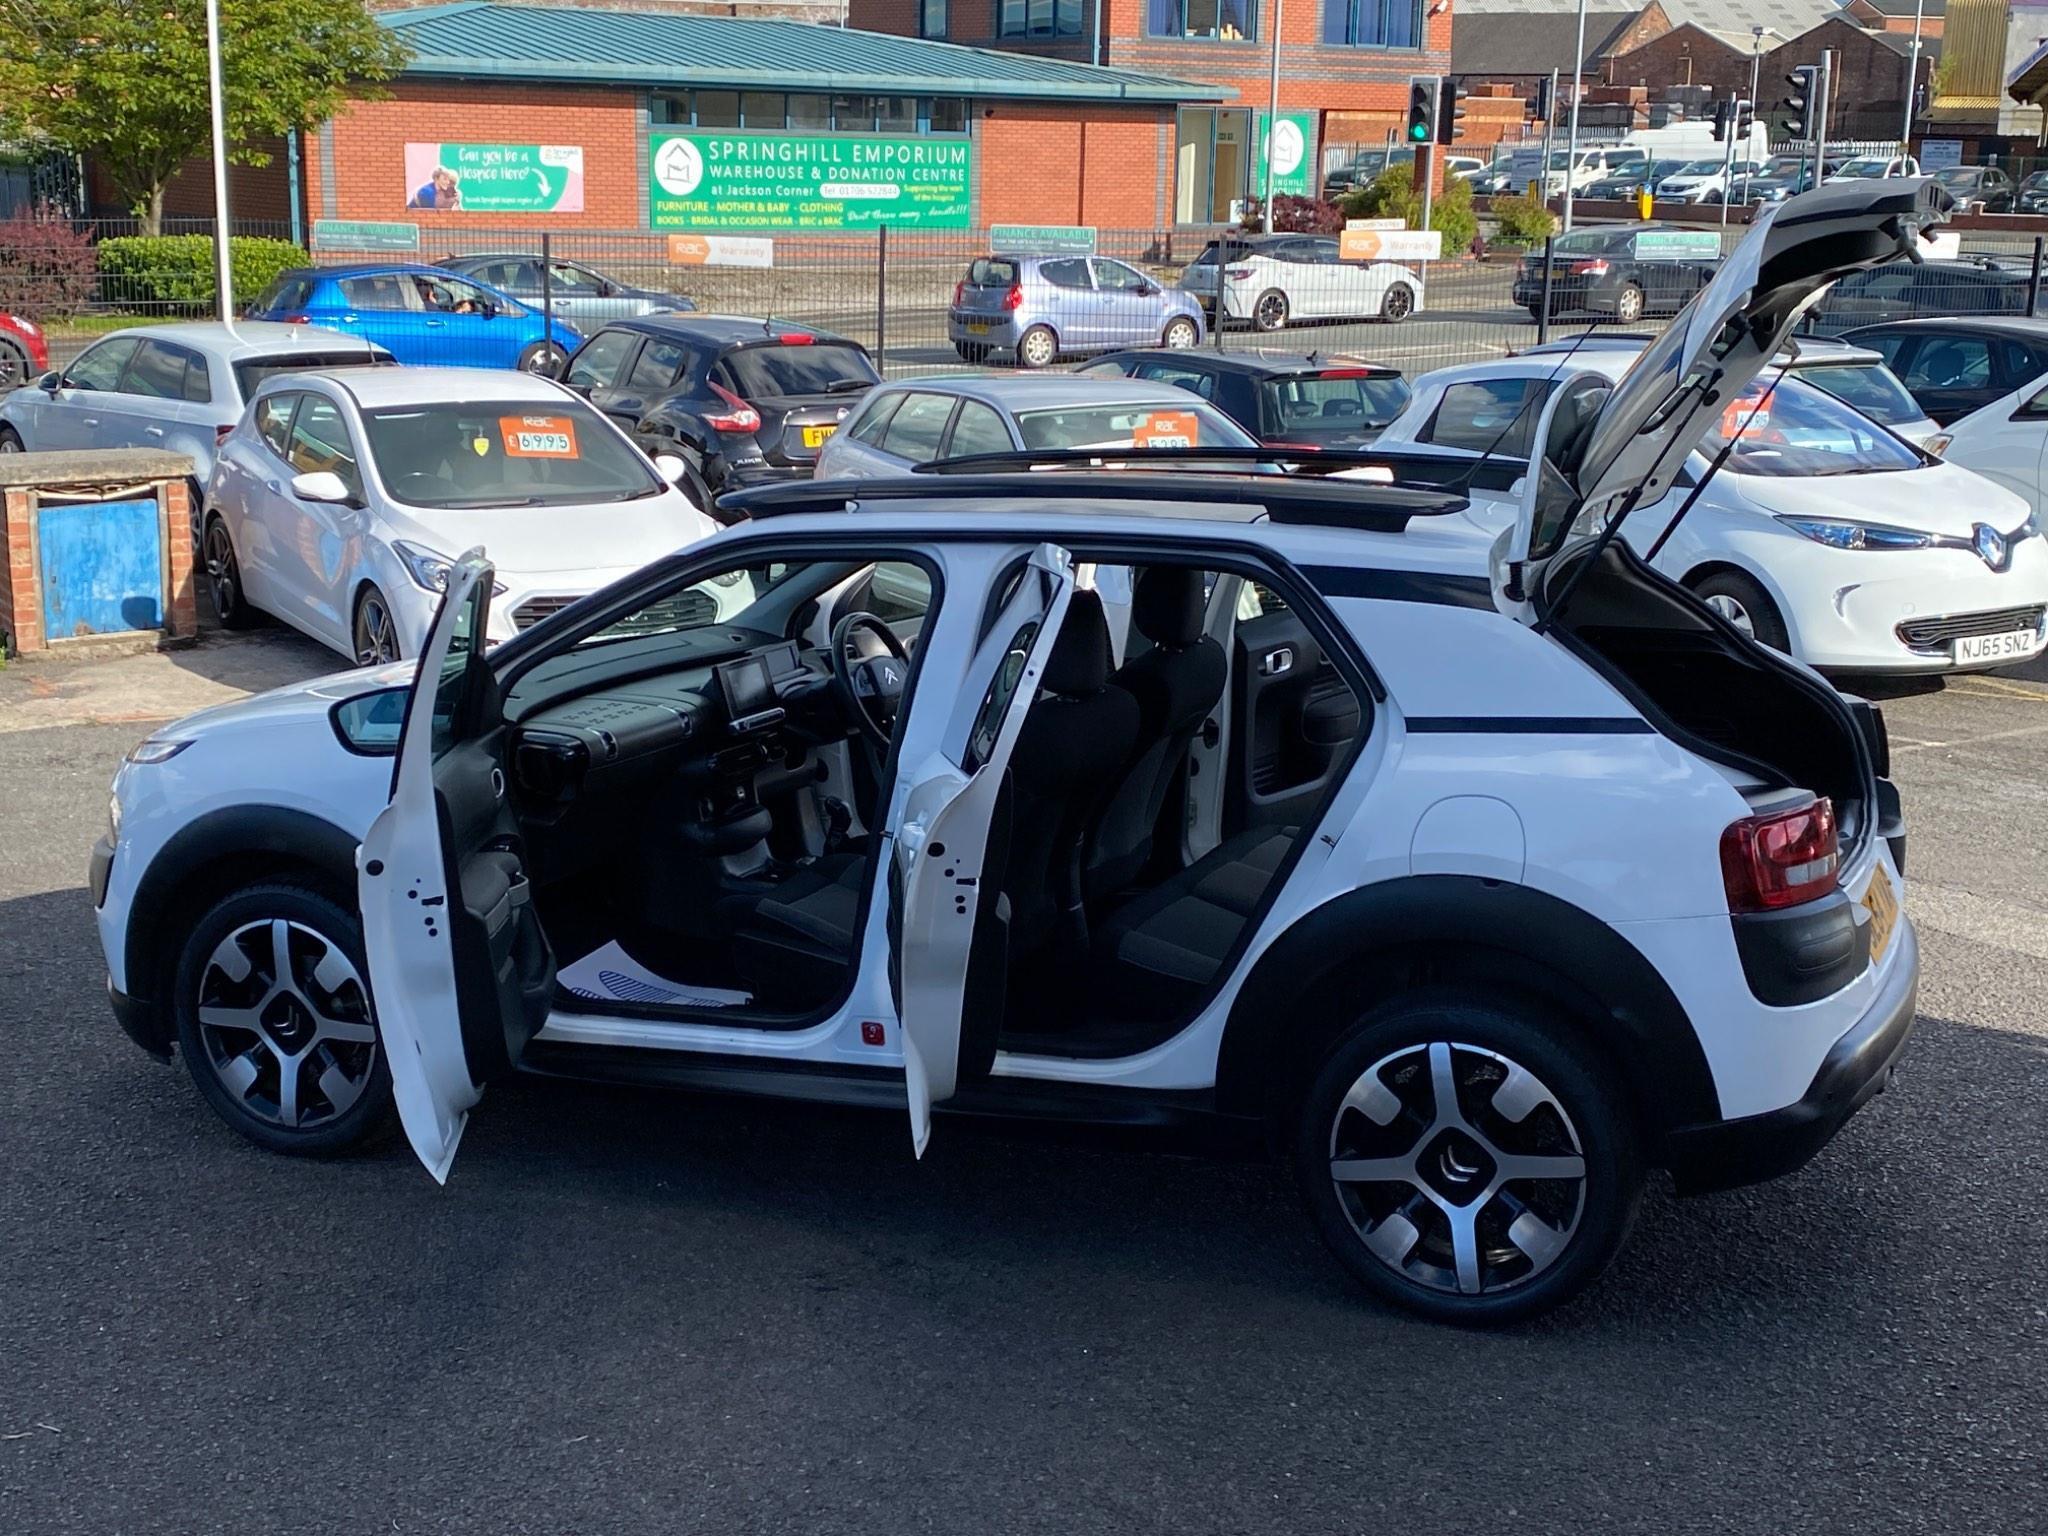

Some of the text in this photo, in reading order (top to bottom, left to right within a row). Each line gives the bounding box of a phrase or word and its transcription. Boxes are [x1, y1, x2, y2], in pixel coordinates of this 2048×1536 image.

[459, 147, 479, 162] Can
[482, 150, 501, 167] you
[504, 148, 518, 163] be
[709, 141, 965, 164] SPRINGHILL EMPORIUM
[459, 166, 498, 184] Hospice
[710, 165, 964, 182] WAREHOUSE & DONATION CENTRE
[711, 185, 722, 196] at
[727, 185, 771, 196] Jackson
[775, 185, 814, 197] Corner
[657, 201, 709, 212] FURNITURE
[716, 202, 755, 212] MOTHER
[757, 203, 765, 212] &
[767, 203, 789, 212] BABY
[800, 203, 843, 213] CLOTHING
[656, 216, 684, 225] BOOKS
[692, 216, 719, 225] BRIDAL
[720, 216, 727, 225] &
[729, 216, 770, 225] OCCASION
[771, 217, 793, 226] WEAR
[800, 217, 816, 226] BRIC
[824, 217, 843, 226] BRAC
[317, 222, 416, 236] FINANCE AVAILABLE
[993, 228, 1093, 240] FINANCE AVAILABLE
[720, 246, 765, 258] Warranty
[1390, 239, 1432, 252] Warranty
[1962, 633, 2030, 658] NJ65 SNZ
